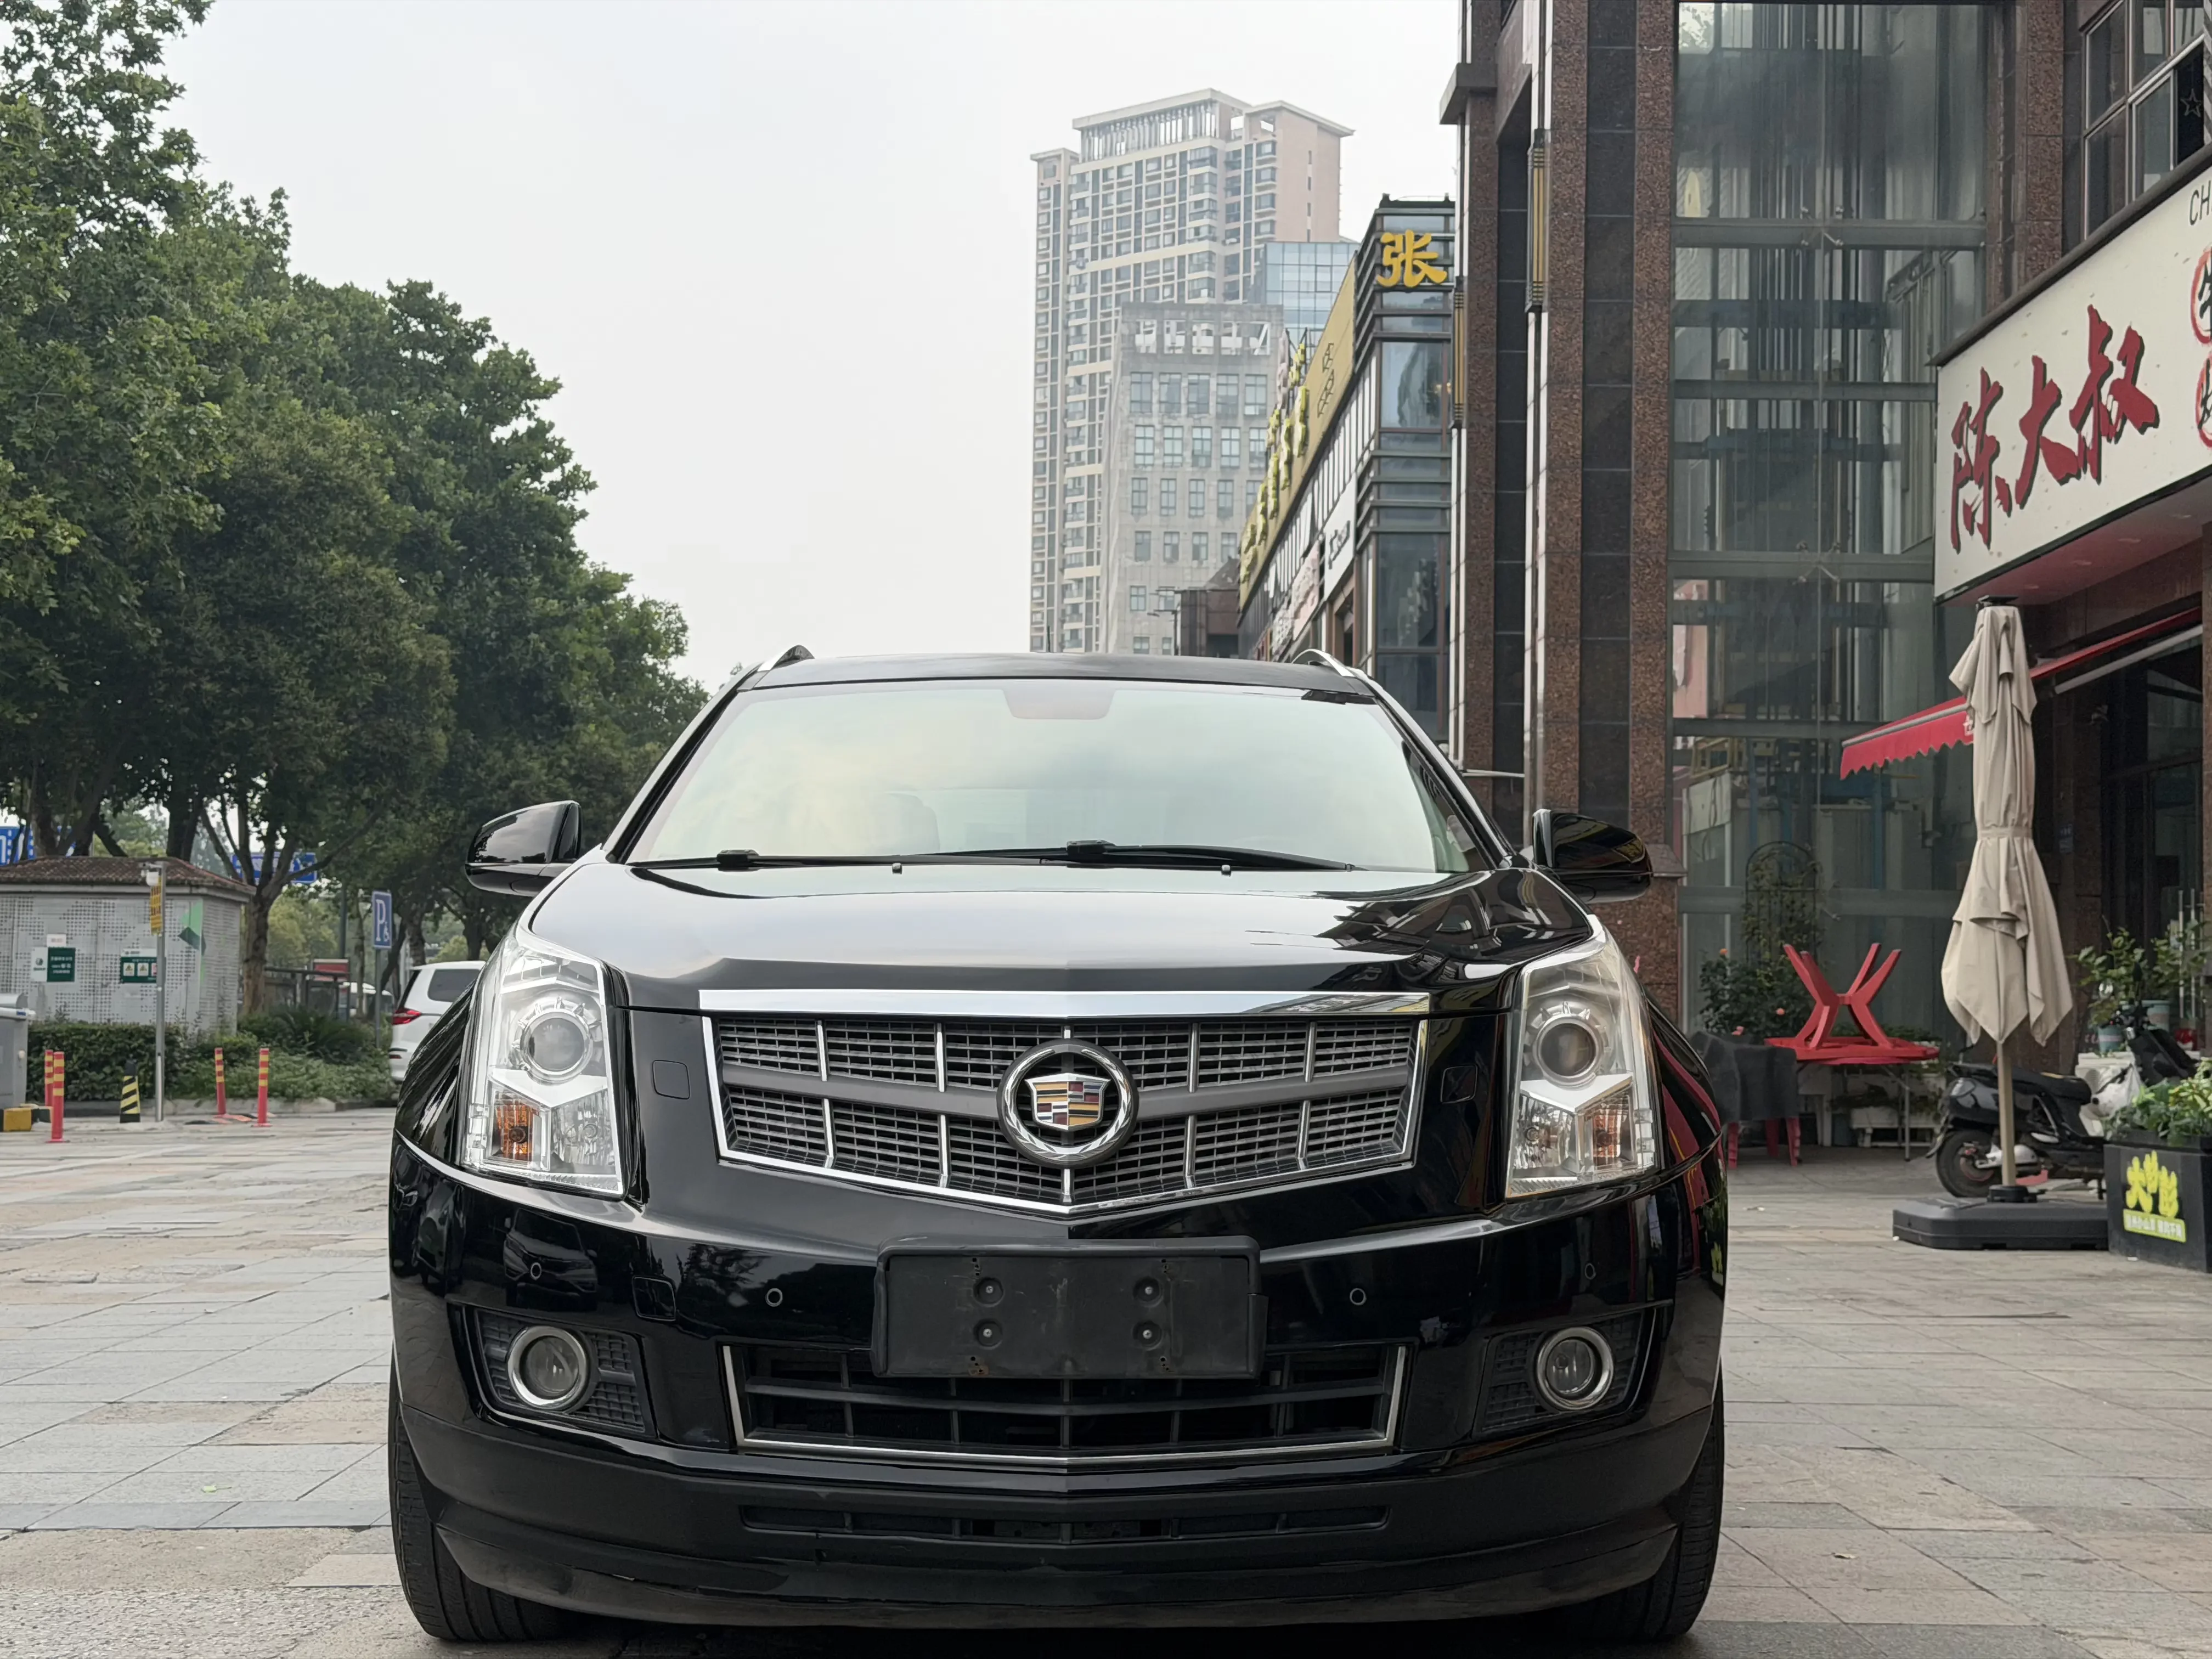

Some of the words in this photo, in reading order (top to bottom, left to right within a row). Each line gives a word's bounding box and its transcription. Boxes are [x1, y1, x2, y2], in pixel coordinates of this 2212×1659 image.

[2190, 180, 2212, 225] CH
[1376, 229, 1447, 287] 张
[1951, 303, 2160, 554] 陈大叔
[375, 899, 386, 941] P
